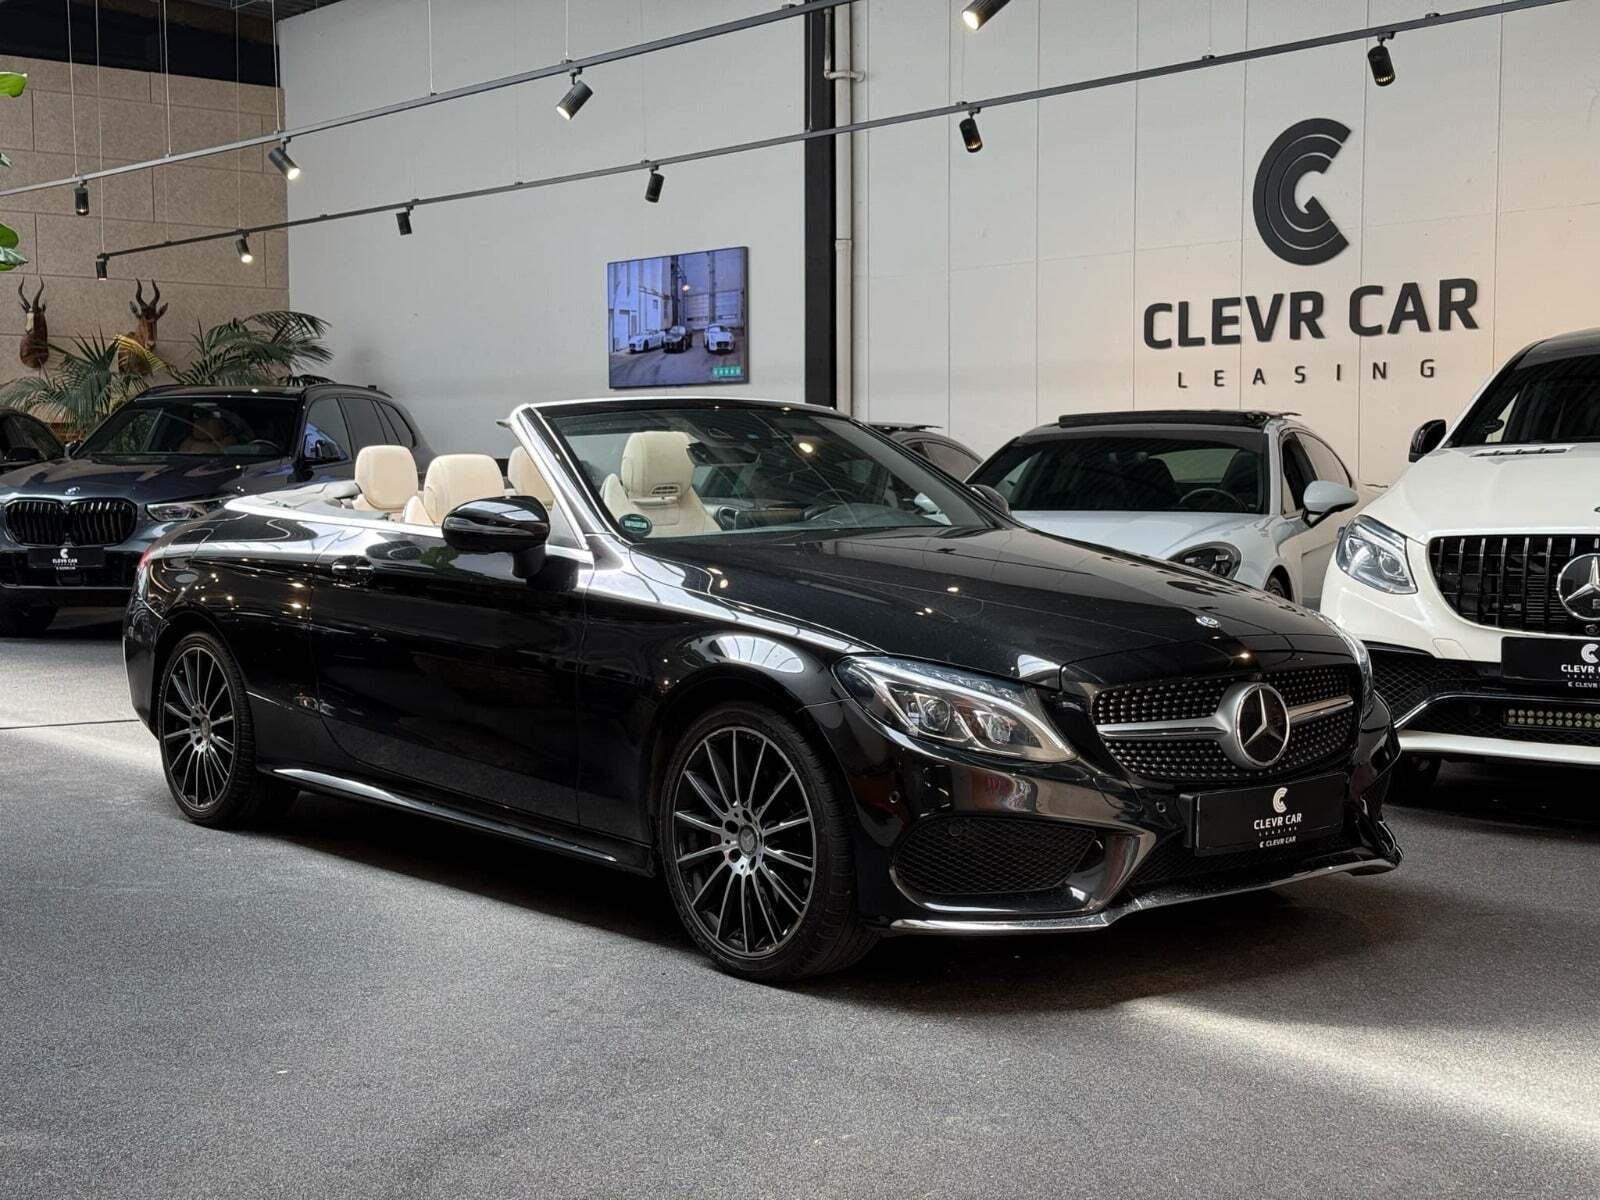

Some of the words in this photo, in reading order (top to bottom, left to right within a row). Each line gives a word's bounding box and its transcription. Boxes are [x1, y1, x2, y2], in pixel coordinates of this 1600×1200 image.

[1143, 291, 1325, 350] CLEVR
[1349, 278, 1479, 337] CAR
[1177, 359, 1435, 389] LEASING
[1561, 664, 1595, 674] CLEVR
[1253, 816, 1283, 830] CLEVR
[1285, 812, 1302, 825] CAR
